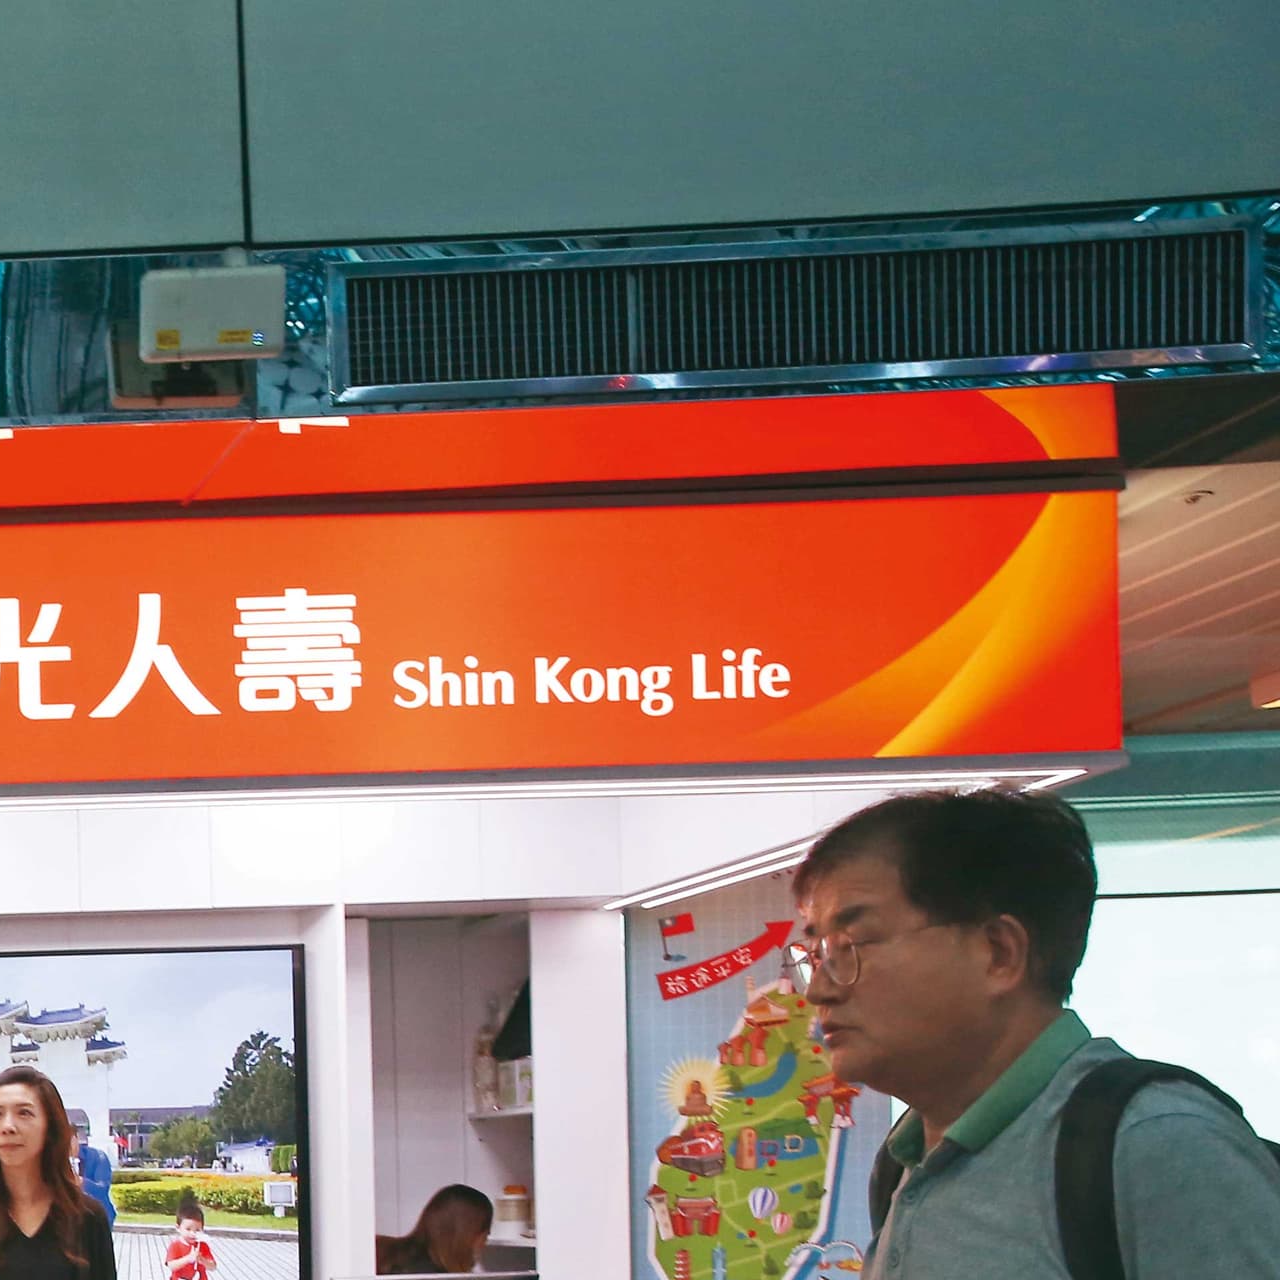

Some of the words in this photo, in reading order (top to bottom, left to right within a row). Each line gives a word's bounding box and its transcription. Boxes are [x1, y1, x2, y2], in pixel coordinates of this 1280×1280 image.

[393, 656, 516, 709] Shin
[535, 655, 674, 717] Kong
[691, 648, 792, 702] Life
